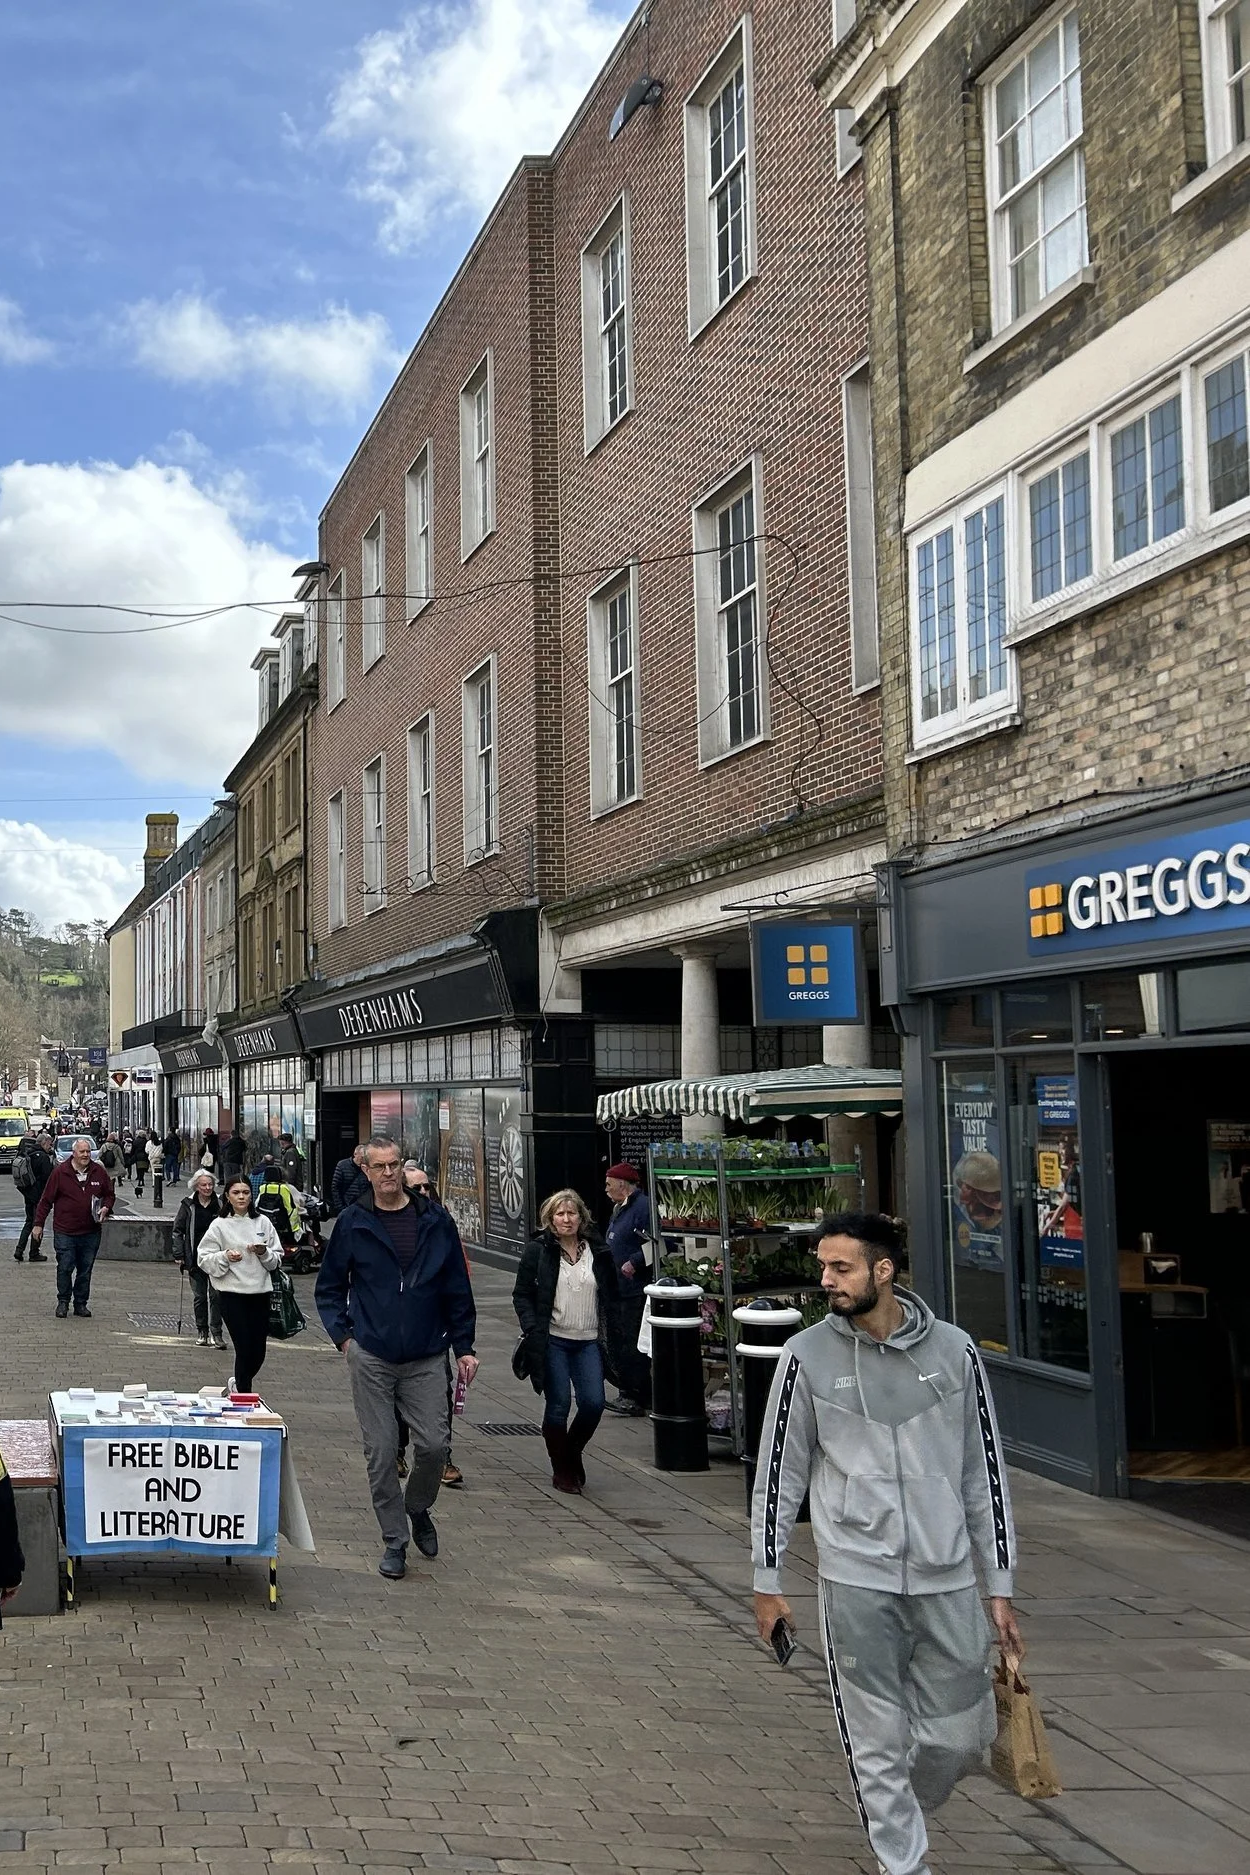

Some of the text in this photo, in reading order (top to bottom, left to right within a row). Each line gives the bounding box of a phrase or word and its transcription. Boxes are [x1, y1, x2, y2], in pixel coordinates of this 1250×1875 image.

[1068, 843, 1250, 930] GREGGS
[788, 991, 830, 1000] GREGGS
[338, 988, 422, 1037] DEBENHAMS
[233, 1027, 277, 1057] DEBENHAMS
[954, 1102, 993, 1118] EVERYDAY
[962, 1120, 986, 1135] TASTY
[963, 1136, 987, 1152] VALUE
[108, 1442, 239, 1470] FREE BIBLE
[145, 1477, 201, 1503] AND
[100, 1509, 245, 1540] LITERATURE
